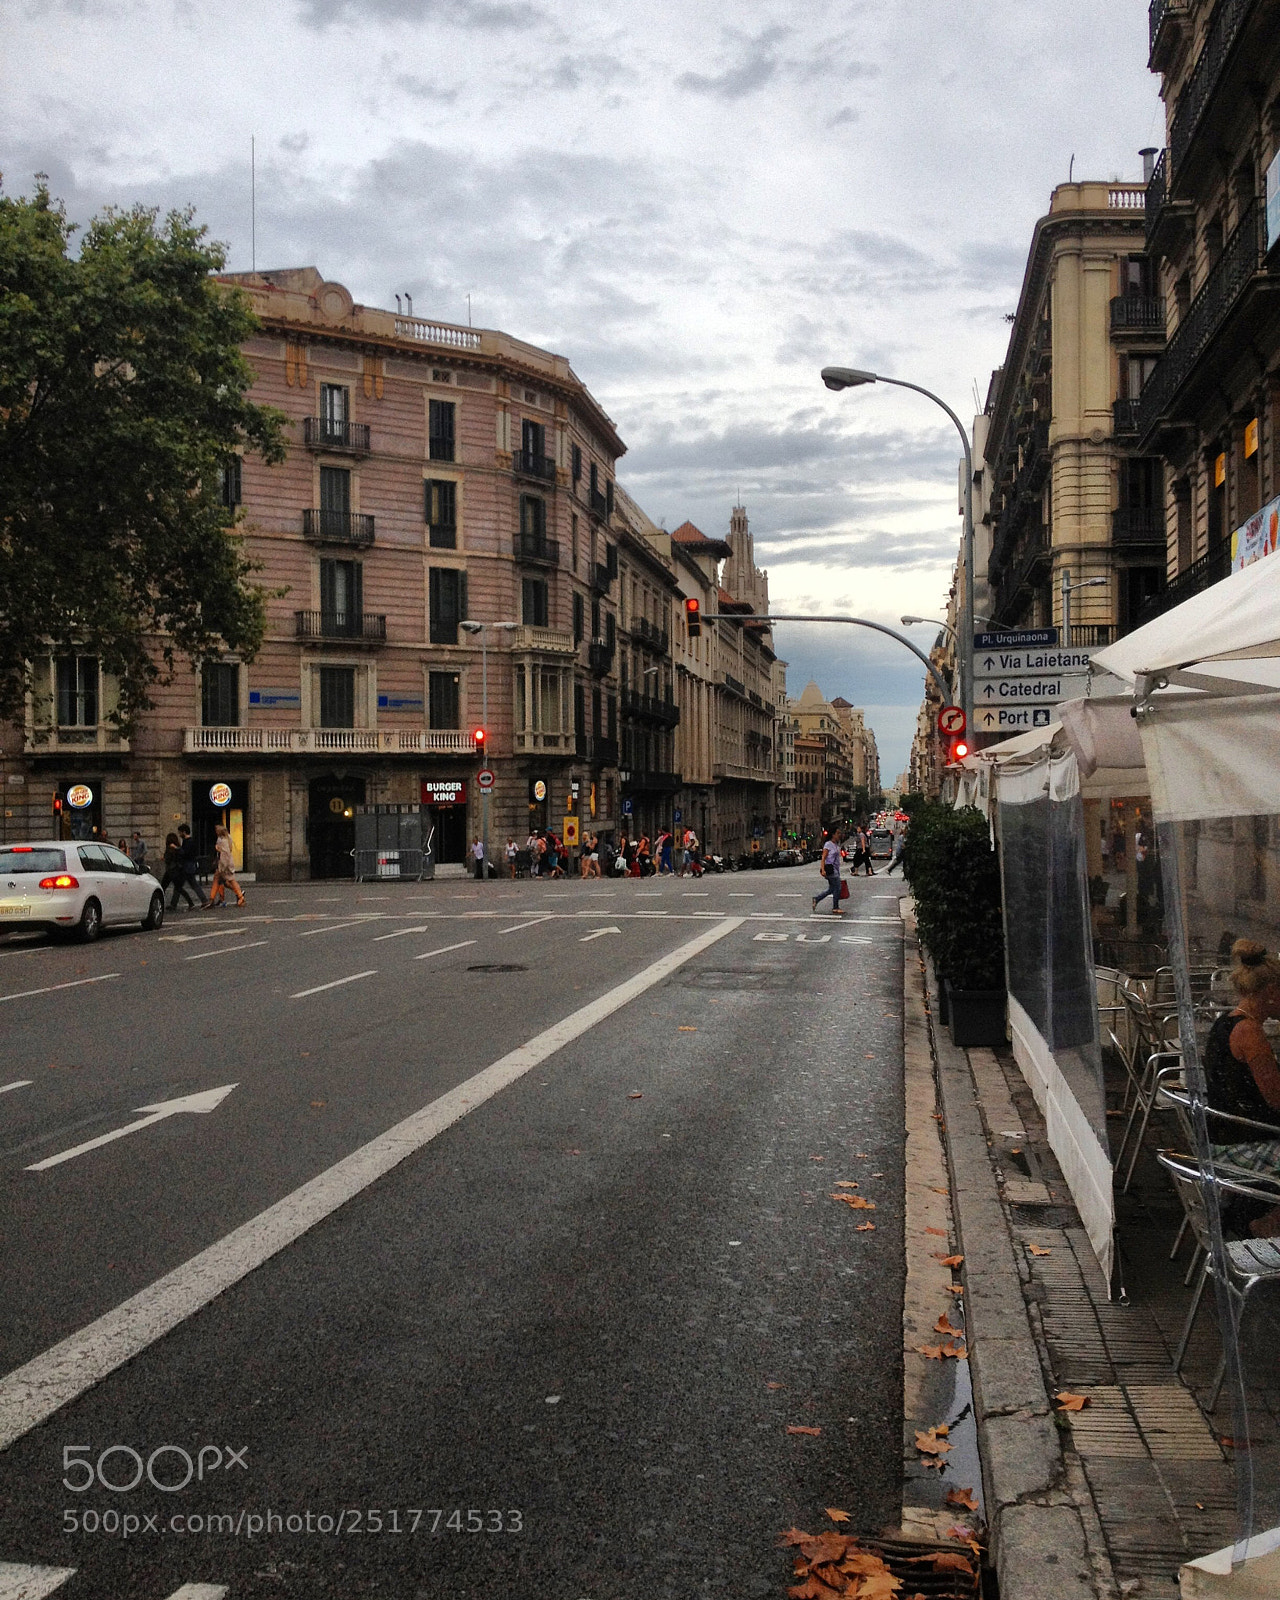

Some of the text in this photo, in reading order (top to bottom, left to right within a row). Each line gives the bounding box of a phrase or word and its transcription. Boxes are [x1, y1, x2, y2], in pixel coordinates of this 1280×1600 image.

[982, 633, 1049, 645] Pl. Urquinaona
[1000, 653, 1090, 669] Via Laietana
[999, 680, 1061, 697] Catedral
[999, 710, 1029, 725] Port
[426, 782, 462, 792] BURGER
[433, 792, 456, 801] KING
[752, 932, 873, 945] BUS
